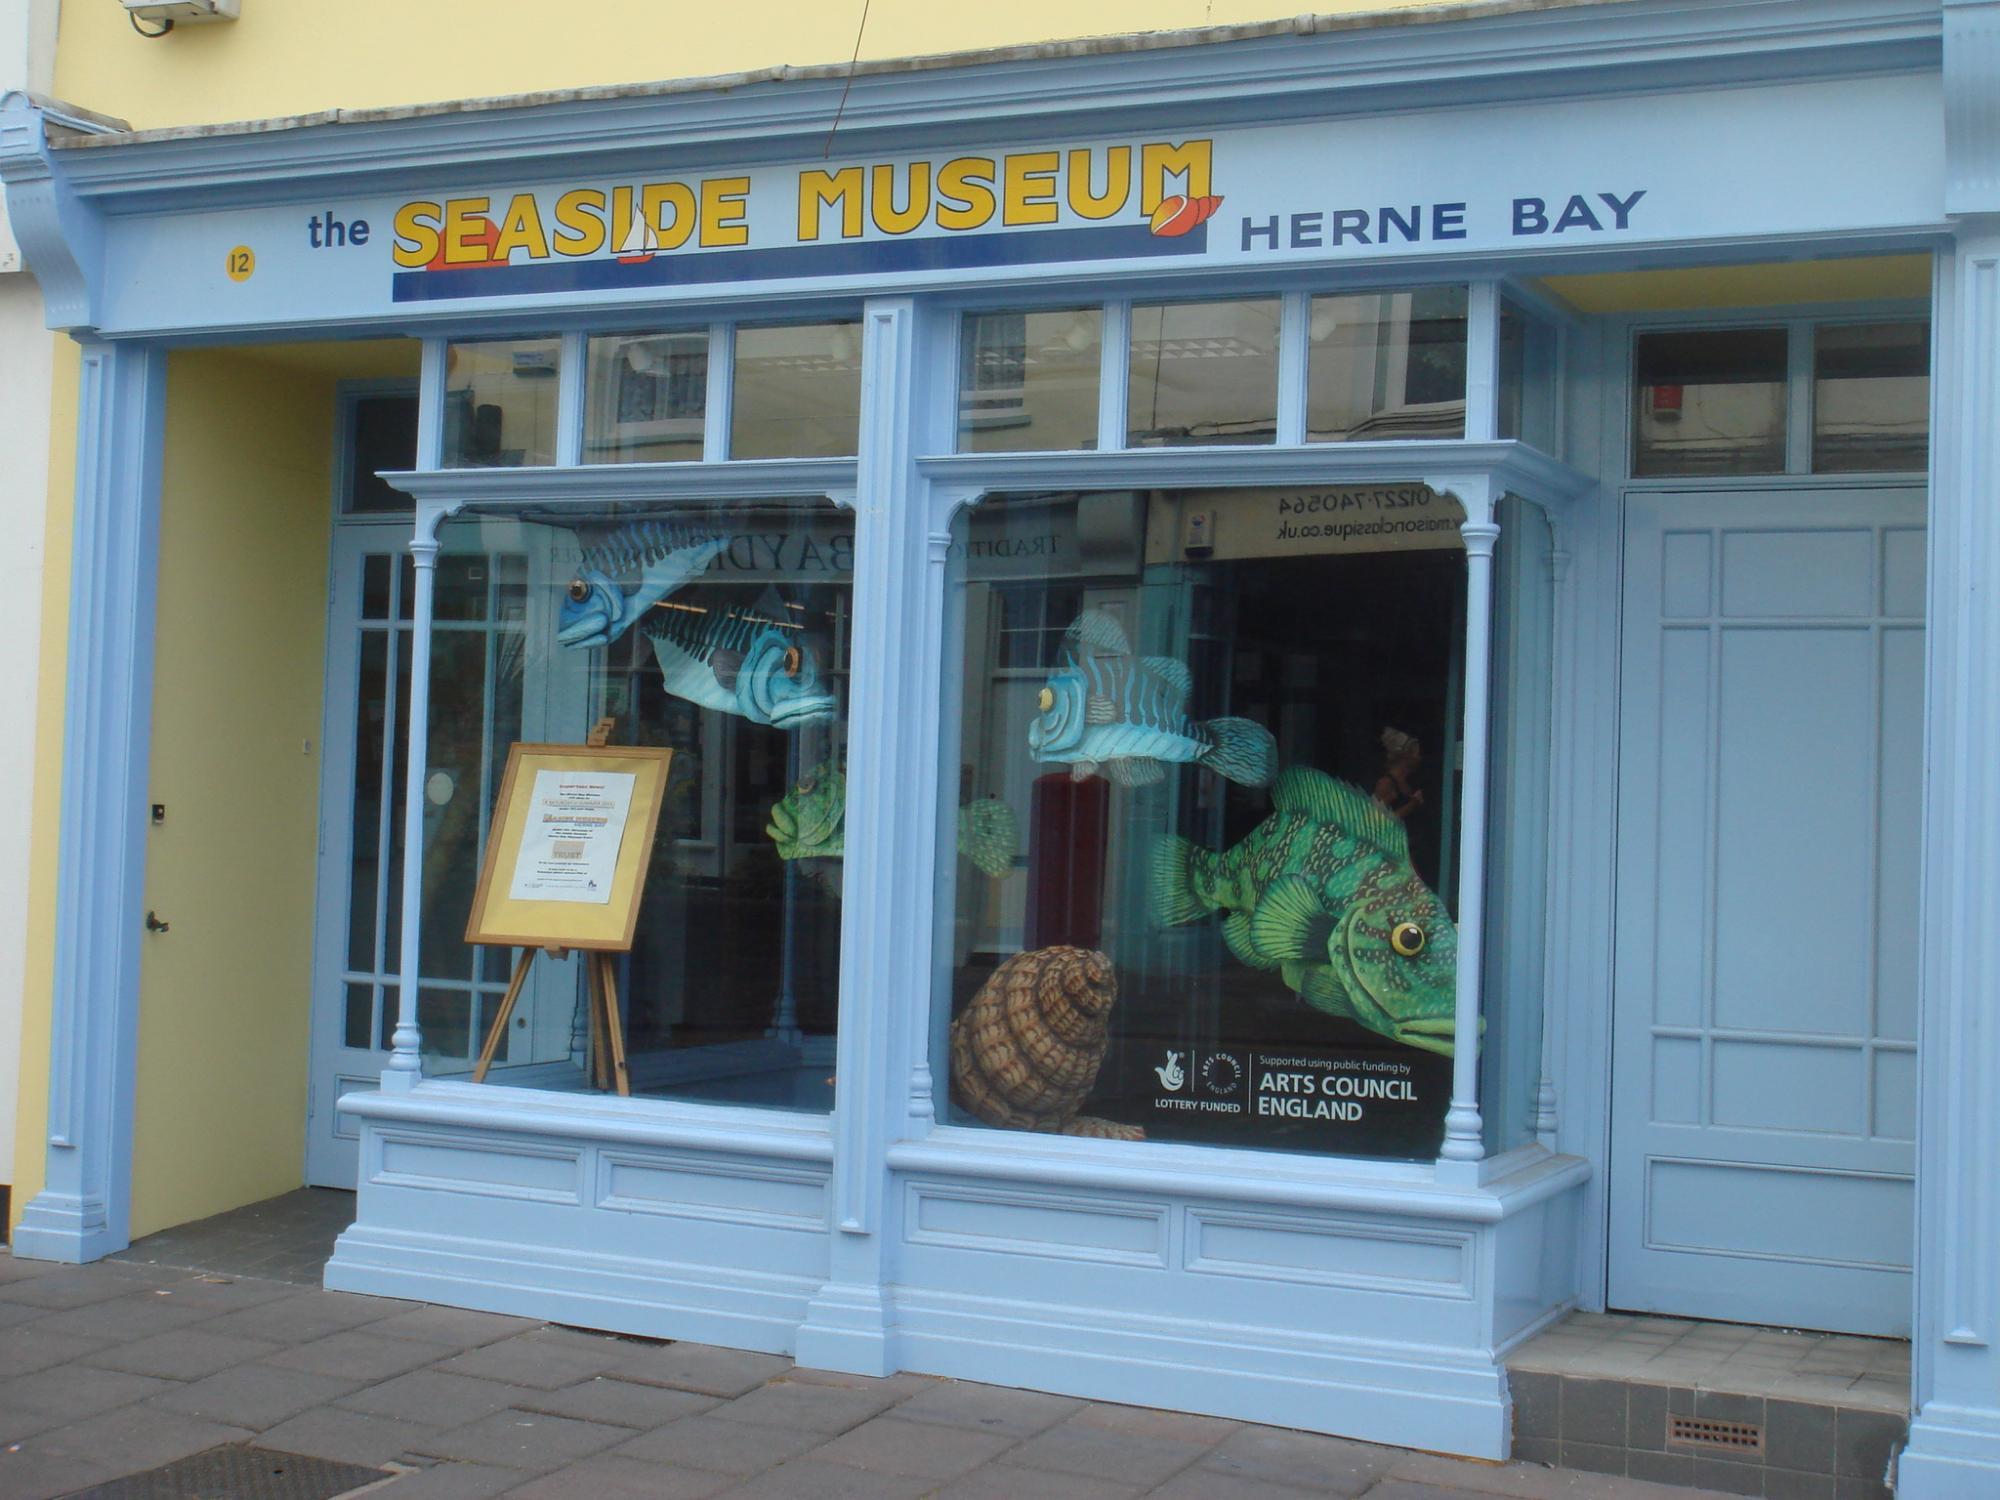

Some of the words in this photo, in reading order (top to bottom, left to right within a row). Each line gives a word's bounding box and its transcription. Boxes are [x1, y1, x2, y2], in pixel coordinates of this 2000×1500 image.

[308, 211, 370, 249] the
[392, 176, 751, 269] SEASIDE
[797, 138, 1213, 242] MUSEUM
[1241, 202, 1467, 251] HERNE
[1512, 190, 1647, 236] BAY
[230, 253, 249, 273] 12
[1202, 1056, 1214, 1077] ARTS
[1216, 1053, 1241, 1079] COUNCIL
[1260, 1055, 1306, 1068] Supported
[1307, 1058, 1332, 1071] using
[1334, 1060, 1360, 1071] public
[1362, 1061, 1398, 1075] funding
[1400, 1063, 1411, 1075] by
[1259, 1072, 1315, 1094] ARTS
[1321, 1076, 1418, 1101] COUNCIL
[1155, 1098, 1198, 1111] LOTTERY
[1200, 1101, 1241, 1113] FUNDED
[1258, 1096, 1363, 1121] ENGLAND
